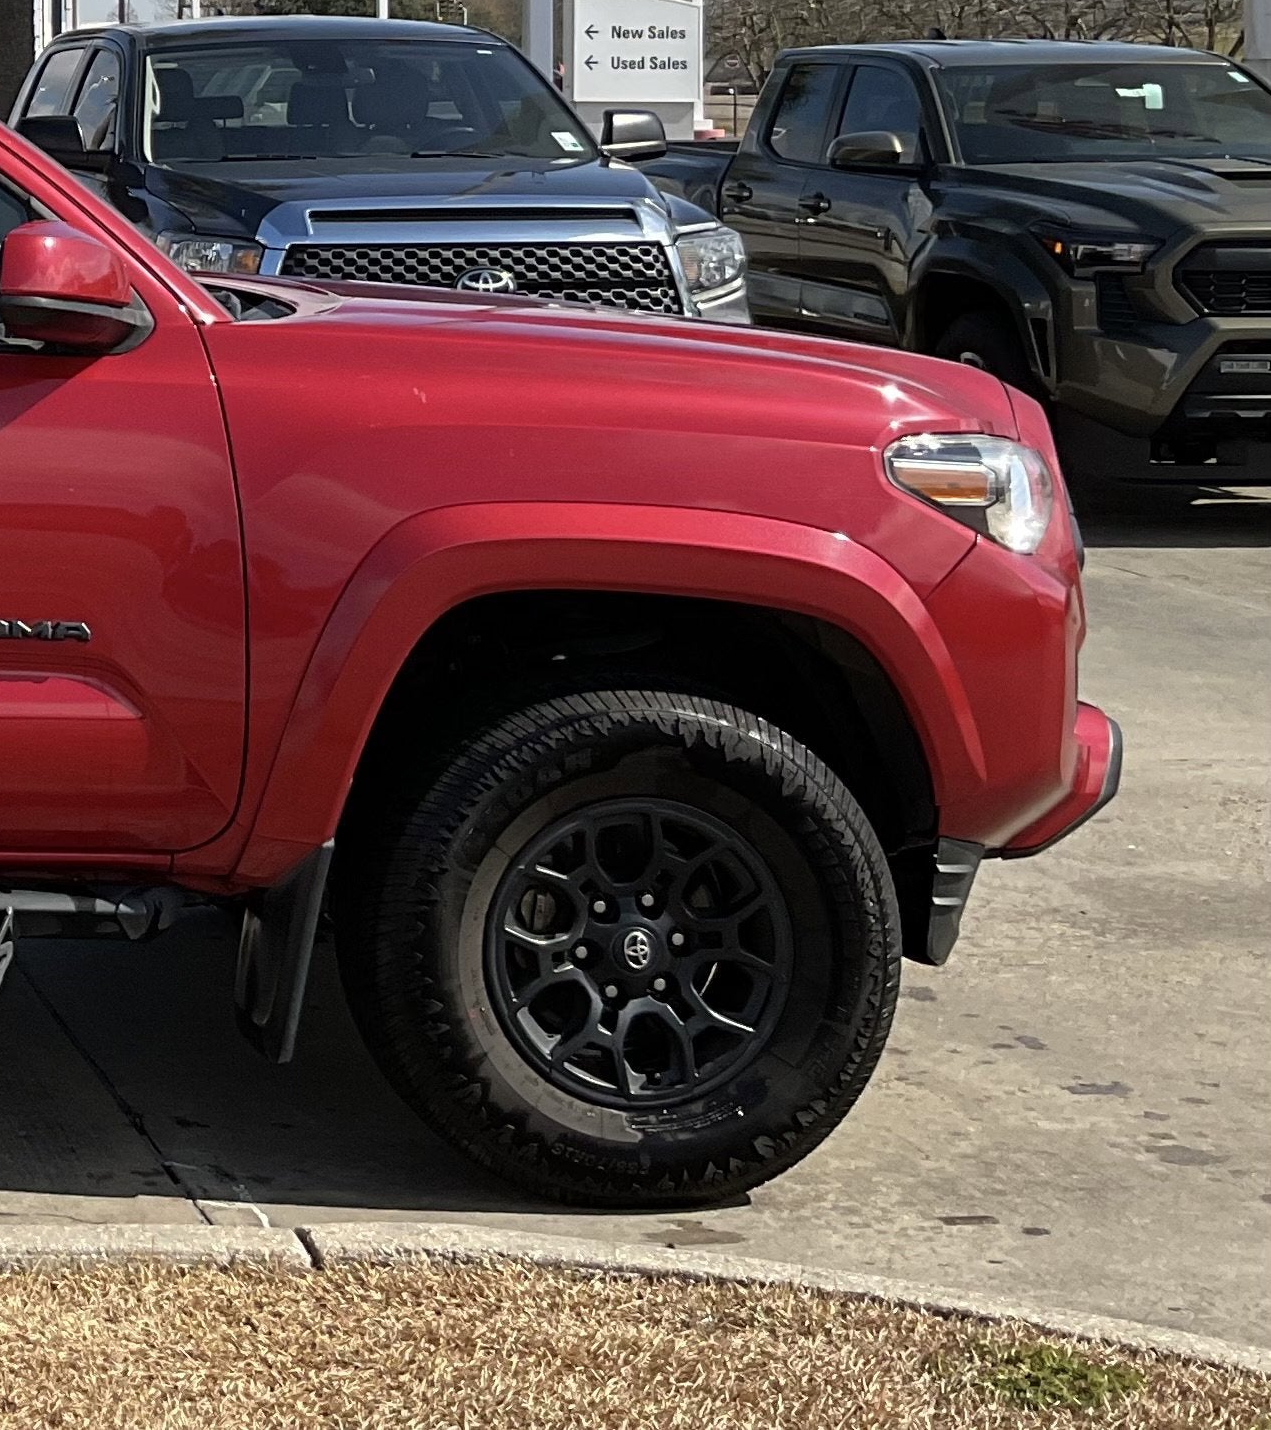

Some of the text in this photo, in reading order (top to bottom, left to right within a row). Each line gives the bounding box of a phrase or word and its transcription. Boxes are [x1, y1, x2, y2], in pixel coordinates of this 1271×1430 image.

[611, 25, 686, 39] New Sales
[611, 56, 688, 70] Used Sales
